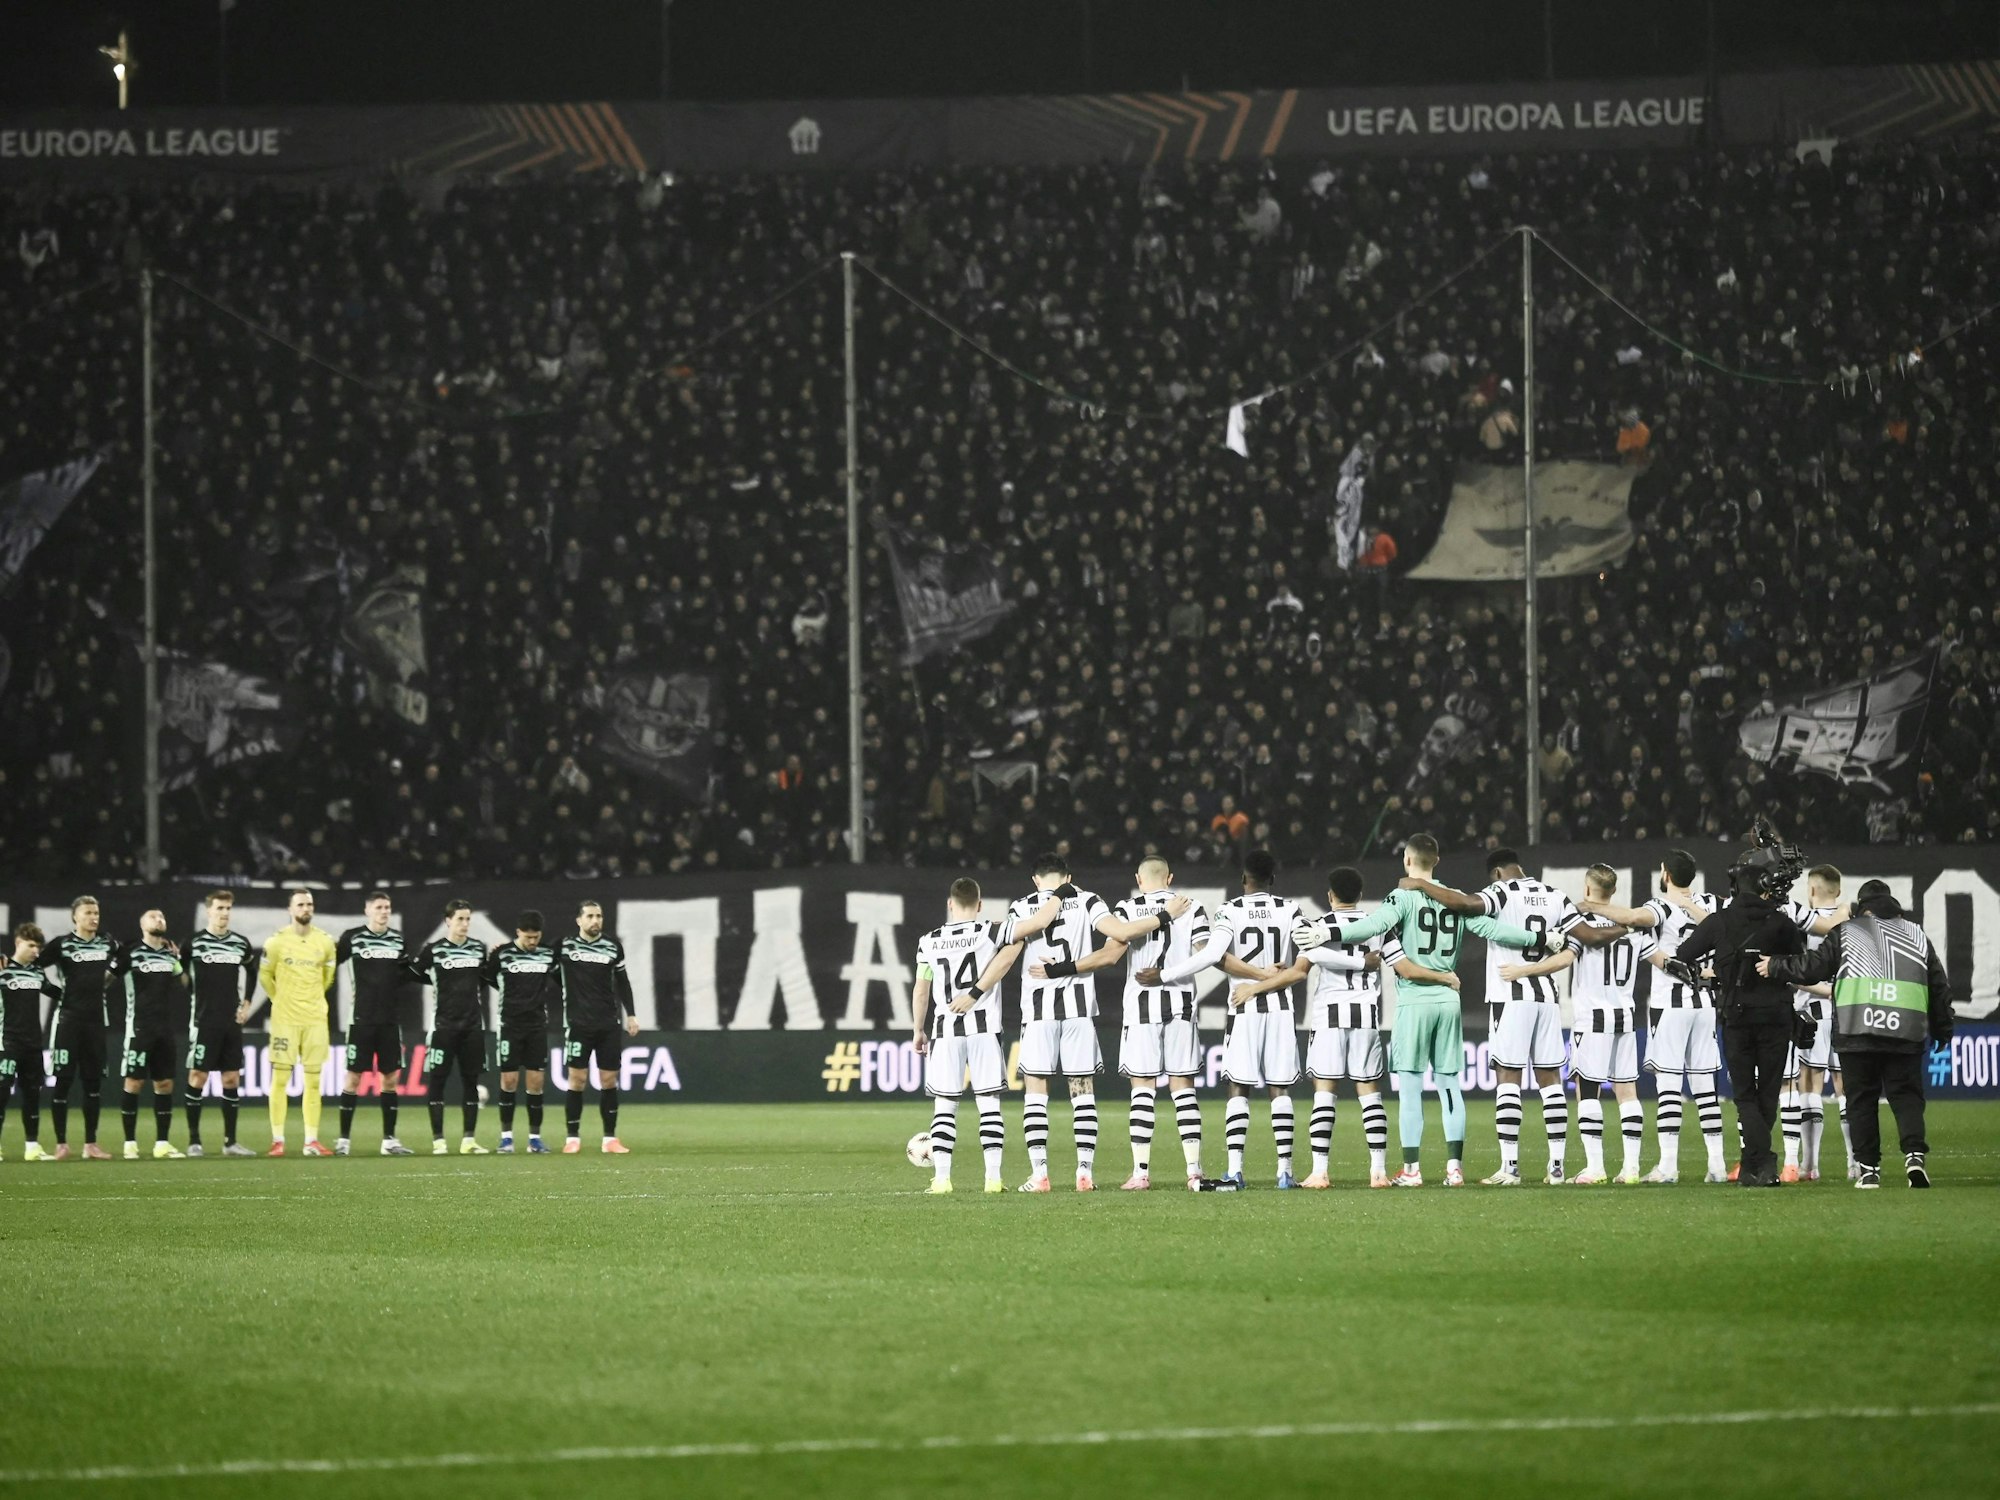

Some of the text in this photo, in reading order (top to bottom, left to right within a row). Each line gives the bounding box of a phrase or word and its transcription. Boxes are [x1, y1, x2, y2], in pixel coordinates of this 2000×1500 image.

[1327, 97, 1705, 136] UEFA EUROPA LEAGUE
[0, 129, 281, 157] EUROPA LEAGUE
[1523, 896, 1548, 906] MEITE
[1248, 909, 1273, 920] BABA
[1417, 906, 1459, 957] 99
[1045, 919, 1072, 964] 5
[1240, 926, 1281, 965] 21
[1603, 937, 1633, 987] 10
[937, 952, 979, 1004] 14
[1869, 981, 1897, 1002] HB
[1864, 1007, 1900, 1030] 026
[195, 1044, 206, 1060] 3
[273, 1037, 289, 1052] 25
[348, 1044, 358, 1060] 6
[500, 1040, 510, 1055] 8
[568, 1041, 583, 1057] 12
[54, 1049, 69, 1064] 18
[128, 1050, 146, 1066] 24
[430, 1048, 444, 1064] 16
